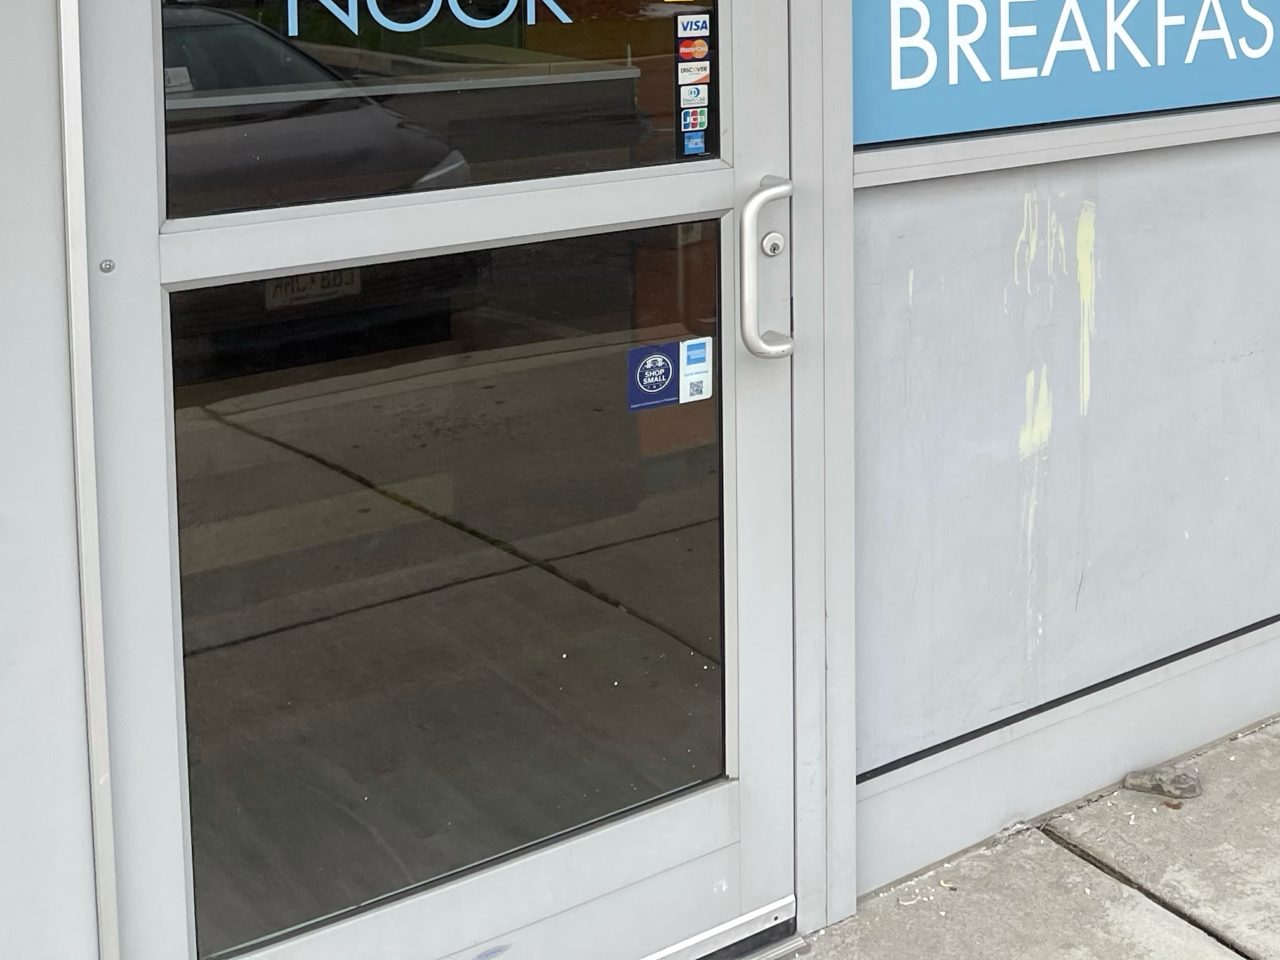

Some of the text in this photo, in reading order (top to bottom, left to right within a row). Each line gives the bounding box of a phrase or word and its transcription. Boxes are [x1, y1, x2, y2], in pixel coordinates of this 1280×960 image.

[681, 20, 708, 31] VISA
[683, 115, 705, 124] JCB
[644, 368, 665, 378] SHOP
[642, 375, 666, 385] SMALL
